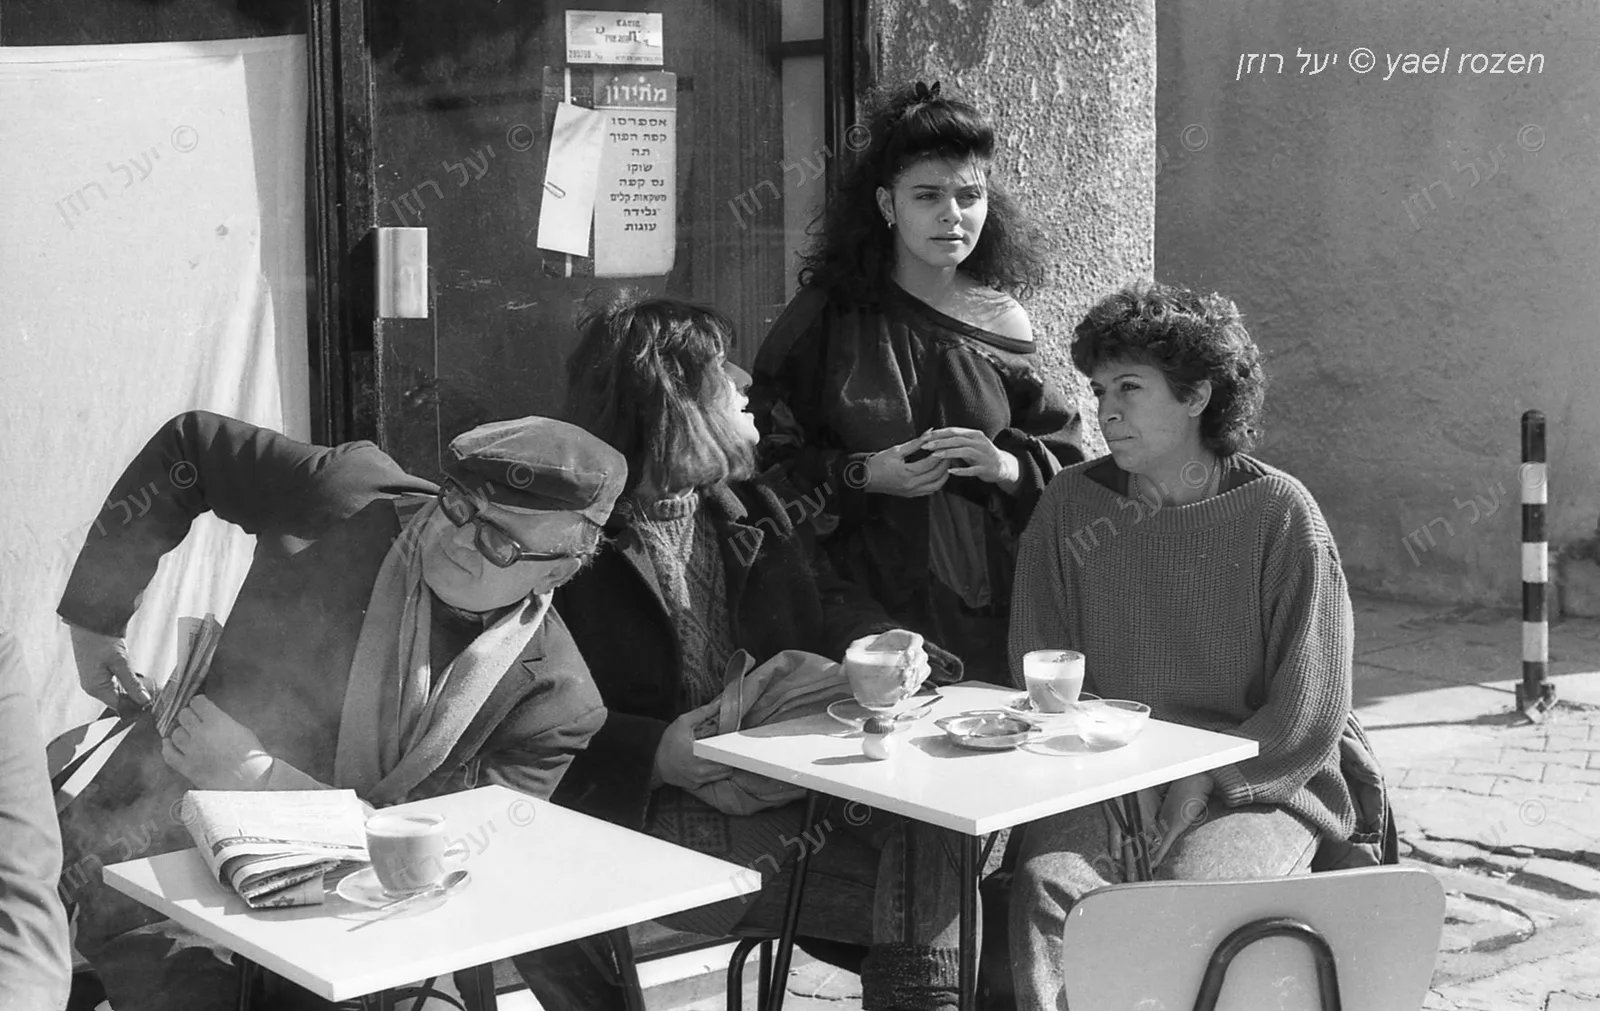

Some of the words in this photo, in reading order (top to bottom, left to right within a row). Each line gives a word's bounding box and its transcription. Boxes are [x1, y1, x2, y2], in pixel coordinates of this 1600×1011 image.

[605, 84, 667, 104] מחירון
[611, 117, 667, 127] אספרסו
[609, 132, 638, 143] הפוך
[643, 133, 667, 143] קפה
[631, 148, 650, 156] תה
[626, 164, 653, 174] שוקו
[619, 179, 645, 189] קפה
[651, 179, 664, 187] נס
[610, 192, 631, 204] קלים
[633, 194, 667, 204] משקאות
[624, 206, 657, 216] גלידה
[624, 223, 657, 231] עוגות
